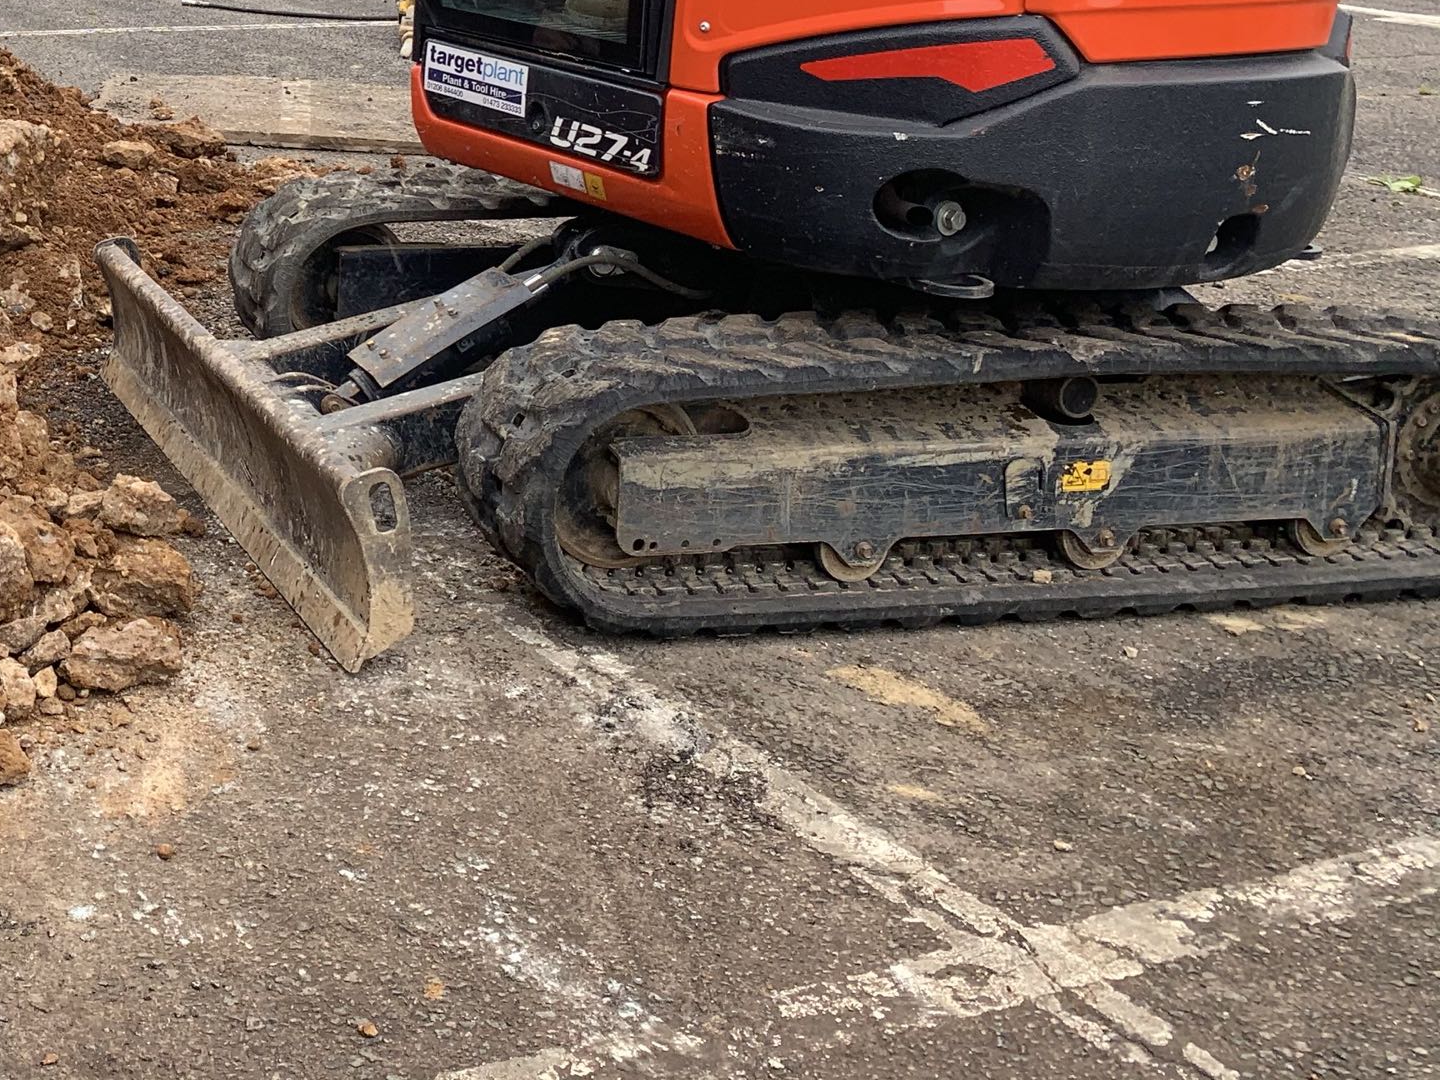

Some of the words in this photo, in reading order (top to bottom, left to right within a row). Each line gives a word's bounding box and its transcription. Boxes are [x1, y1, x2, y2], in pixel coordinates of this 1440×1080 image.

[430, 45, 525, 87] targetplant
[442, 74, 462, 87] Plant
[463, 80, 470, 88] &
[471, 81, 488, 96] Tool
[490, 86, 507, 99] Hire
[482, 97, 500, 108] 01473
[549, 116, 652, 172] U27-4
